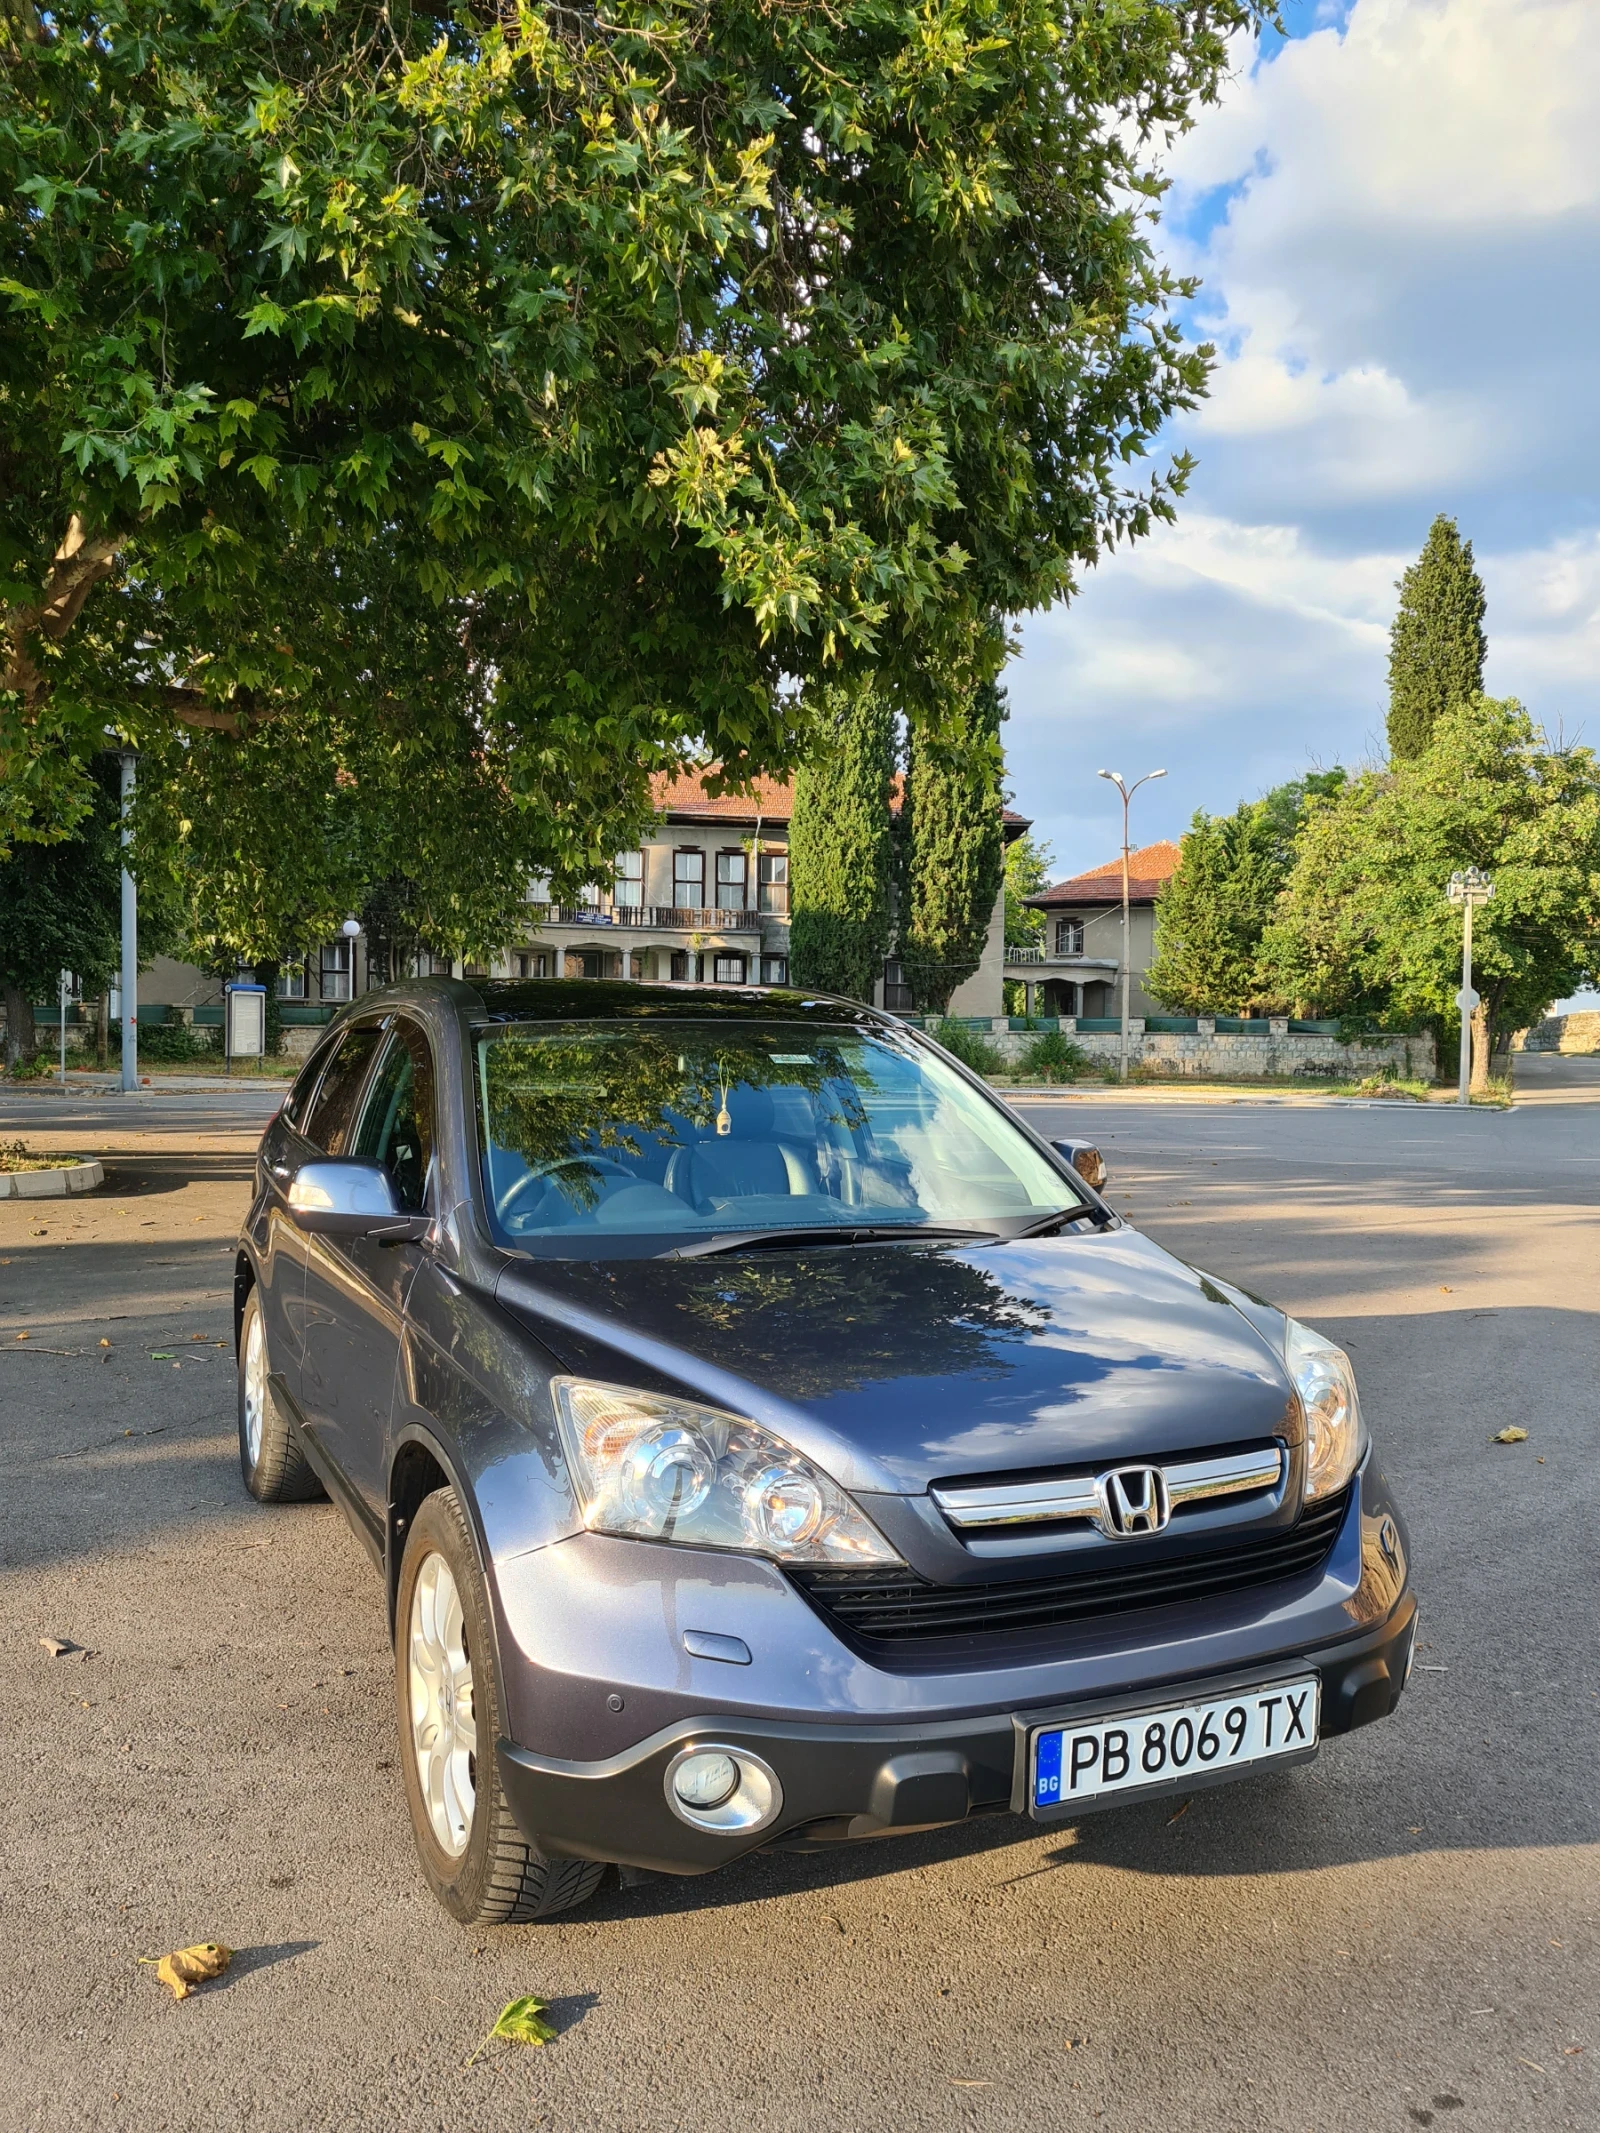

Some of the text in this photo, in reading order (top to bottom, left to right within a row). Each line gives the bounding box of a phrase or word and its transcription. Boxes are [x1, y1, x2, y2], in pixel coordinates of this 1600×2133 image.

[1070, 1691, 1308, 1789] PB 8069 TX
[1038, 1777, 1059, 1793] BG
